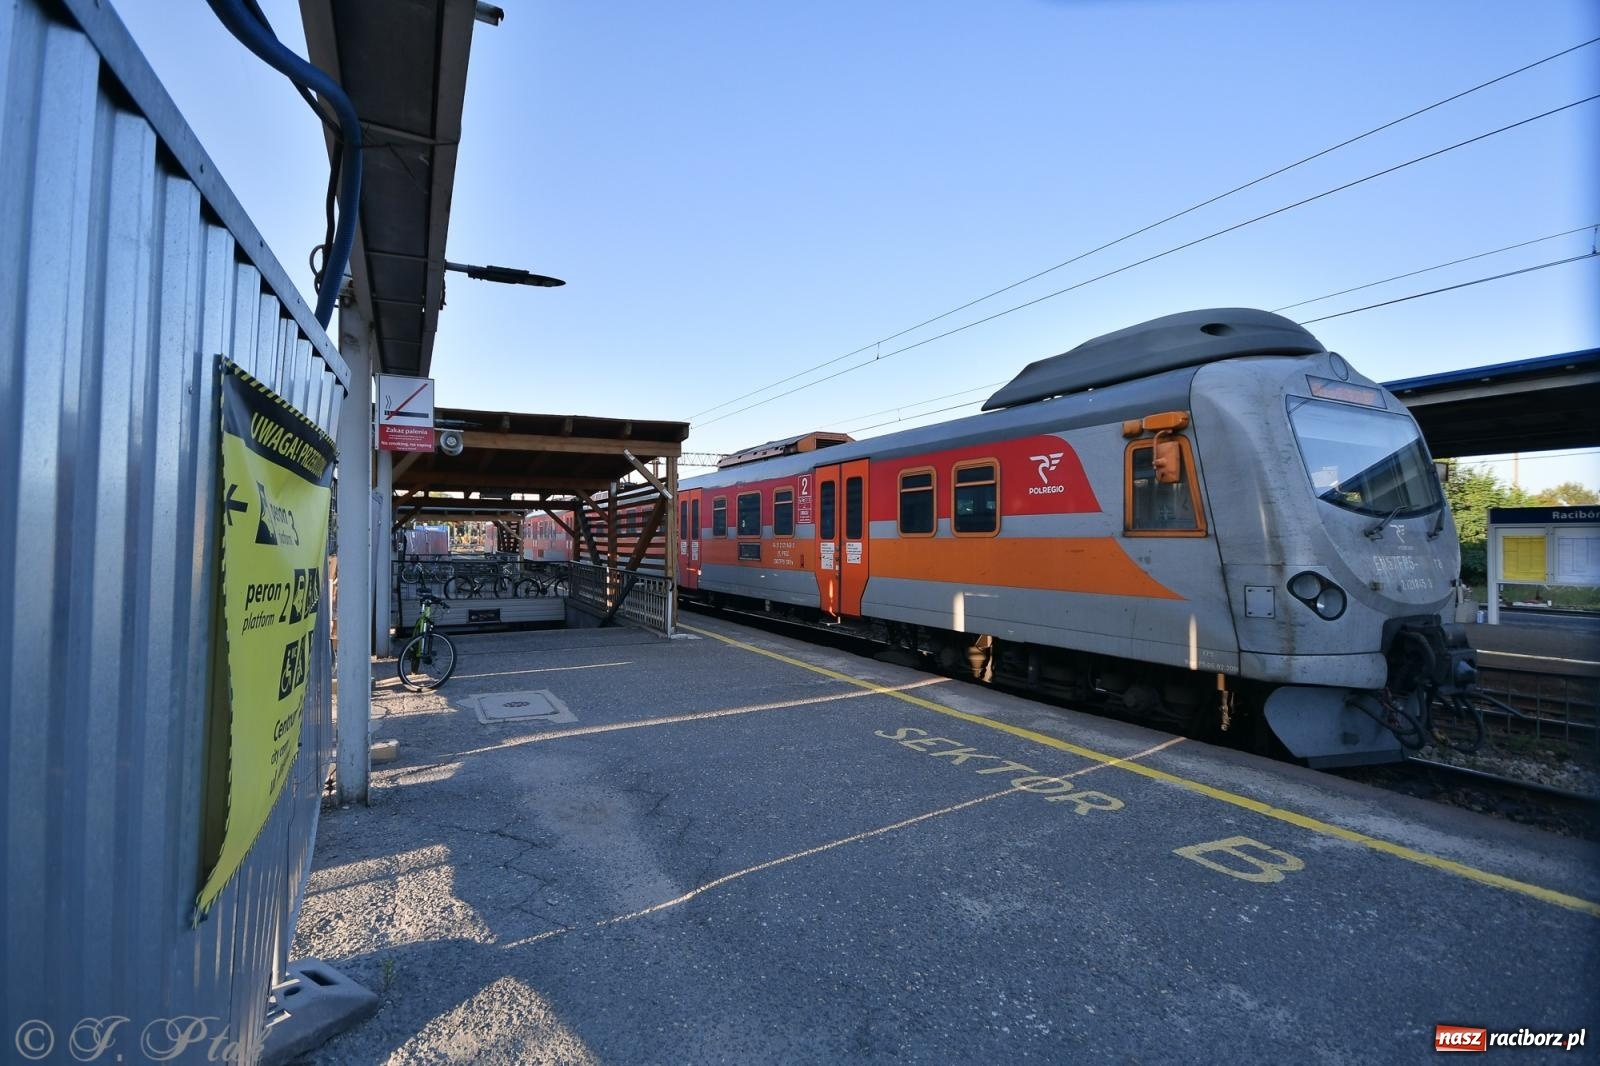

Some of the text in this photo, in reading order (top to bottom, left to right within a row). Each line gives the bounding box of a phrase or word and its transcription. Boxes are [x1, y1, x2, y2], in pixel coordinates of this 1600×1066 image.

[251, 411, 304, 462] UWAGA!
[385, 426, 404, 434] Zakaz
[801, 477, 808, 496] 2
[1028, 485, 1065, 495] POLREGIO
[287, 510, 300, 546] 3
[245, 581, 291, 624] peron 2
[242, 610, 275, 636] platform
[874, 726, 1126, 816] SEKTOR
[1171, 835, 1306, 883] B
